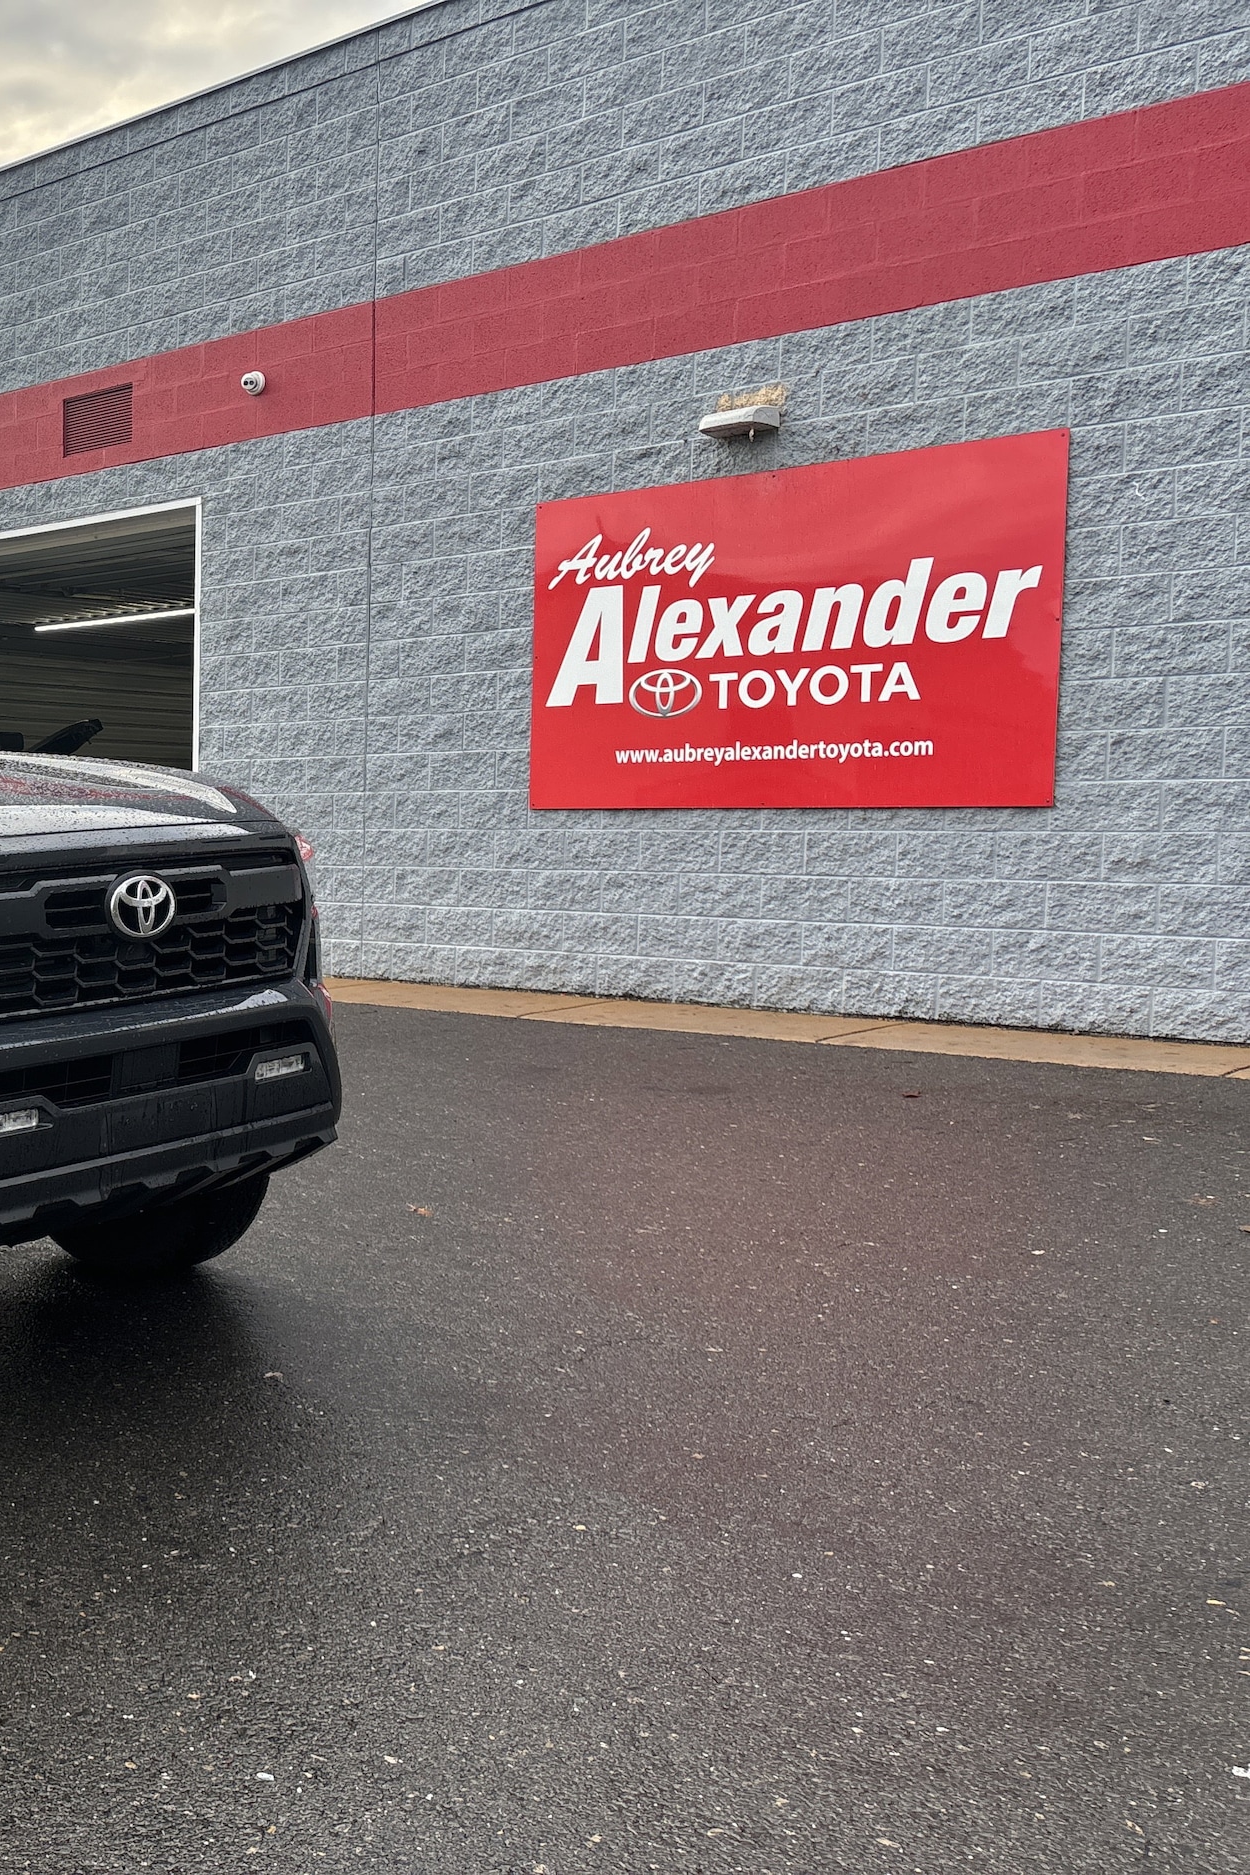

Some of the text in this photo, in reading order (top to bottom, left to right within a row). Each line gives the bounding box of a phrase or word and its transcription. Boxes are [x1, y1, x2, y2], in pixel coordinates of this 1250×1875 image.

[548, 527, 715, 590] Aubrey
[545, 556, 1043, 708] Alexander
[709, 661, 921, 710] TOYOTA
[615, 738, 934, 766] www.aubreyalexandertoyota.com
